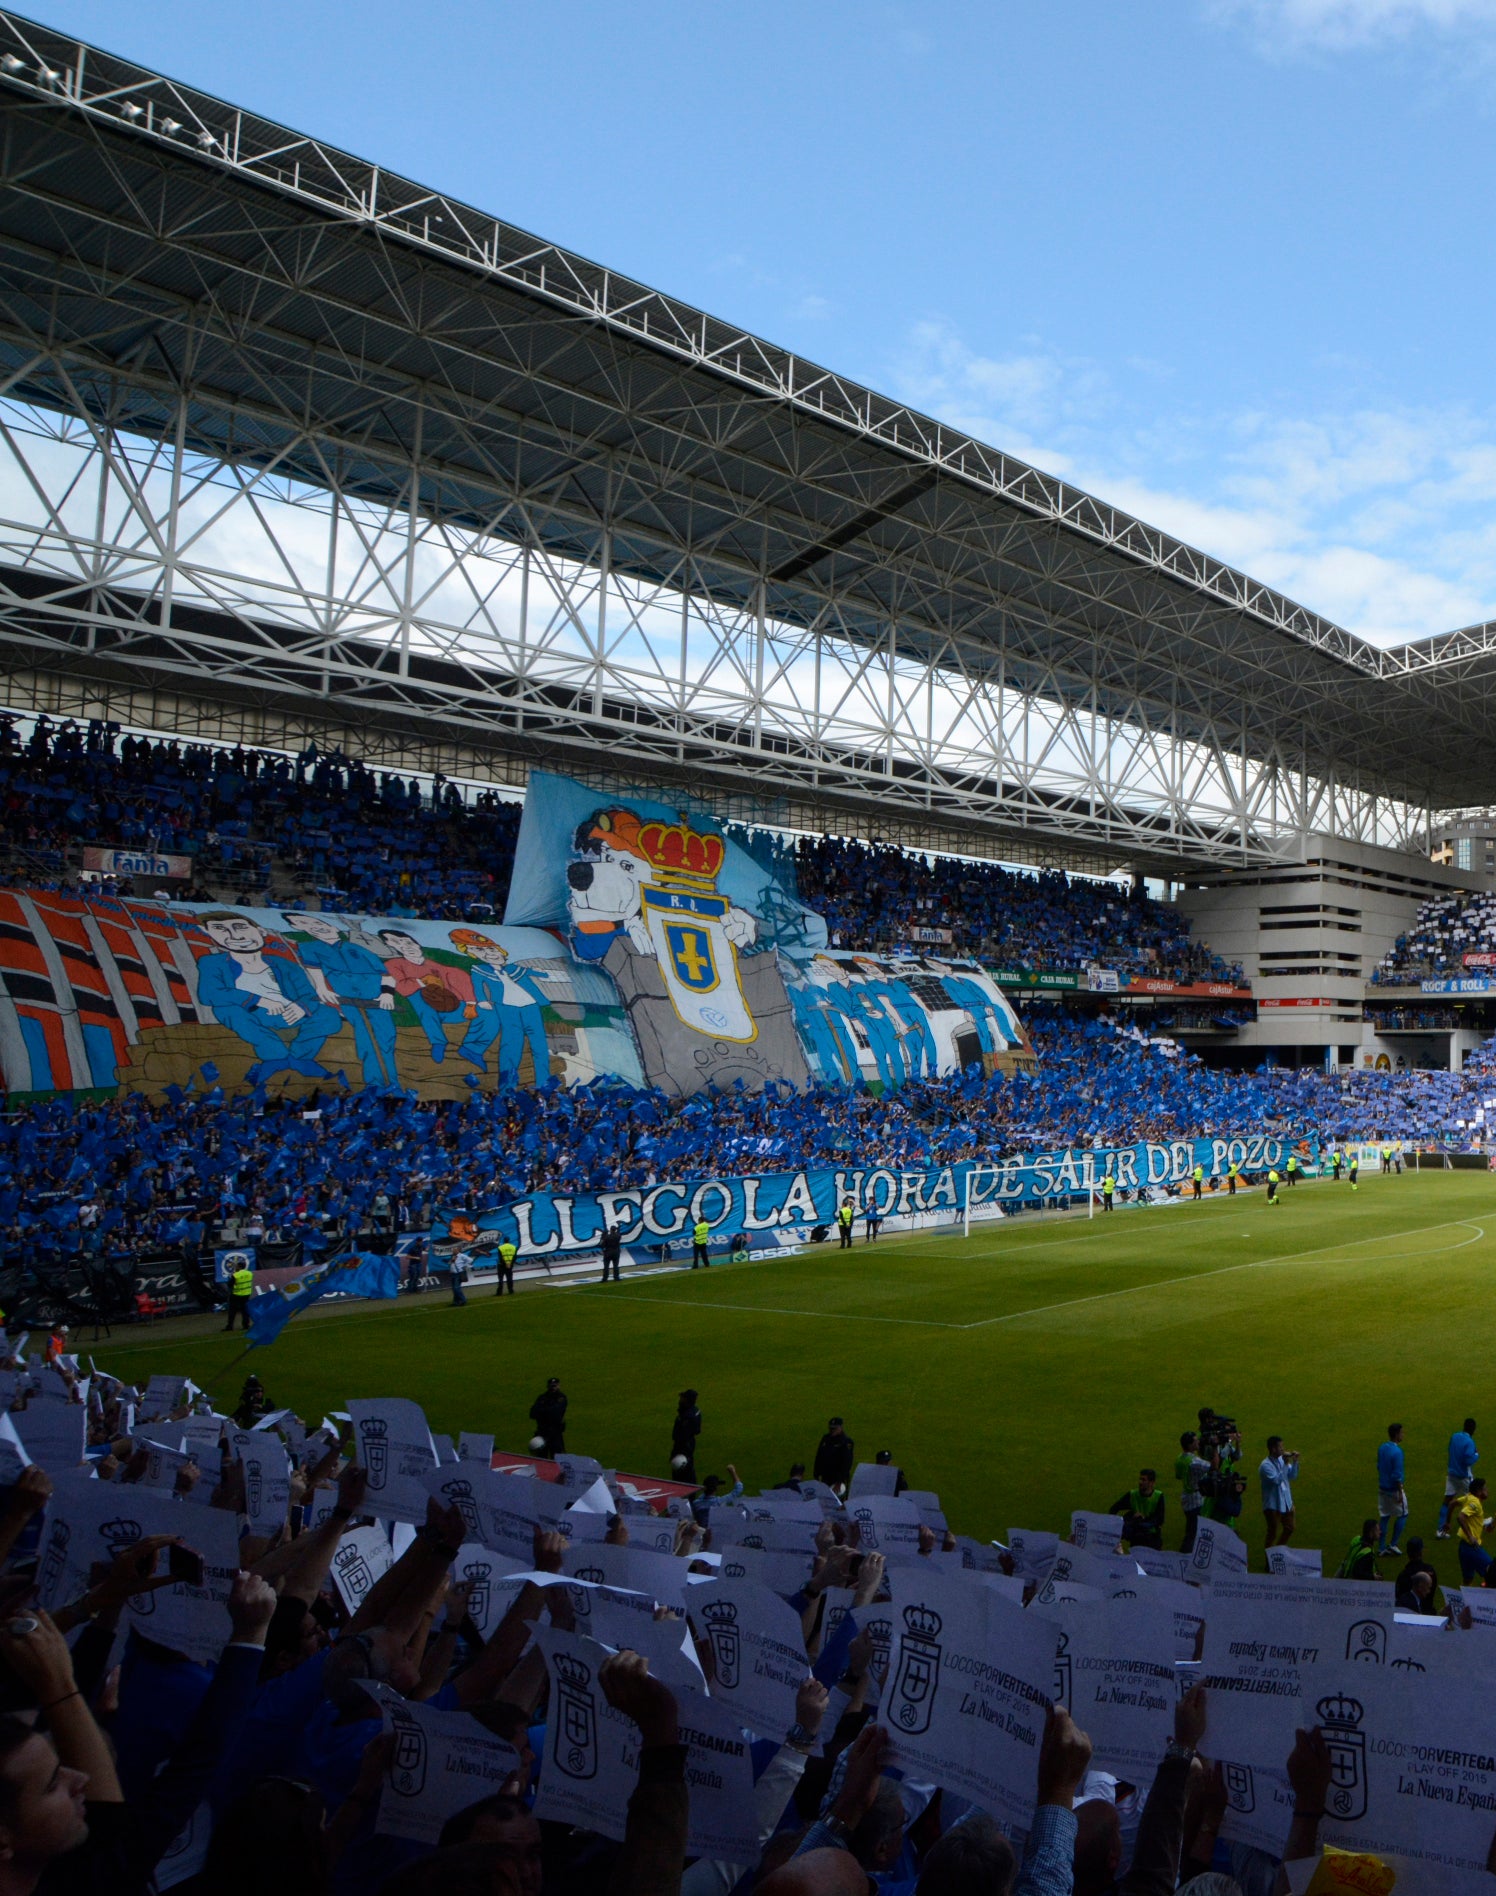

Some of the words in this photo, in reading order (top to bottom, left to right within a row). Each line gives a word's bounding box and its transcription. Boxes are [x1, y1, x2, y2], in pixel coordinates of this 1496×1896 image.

[113, 852, 169, 875] Fanta
[1055, 976, 1075, 985] RURAL
[1147, 981, 1174, 992] cajAstur
[1209, 985, 1233, 995] cajAstur
[1450, 980, 1458, 992] &
[1460, 979, 1486, 991] ROLL
[511, 1181, 735, 1257] LLEGO
[741, 1172, 820, 1231] LA
[833, 1165, 958, 1218] HORA
[969, 1153, 1025, 1201] DE
[1030, 1146, 1140, 1198] SALIR
[1144, 1140, 1196, 1184] DEL
[1210, 1136, 1283, 1176] POZO
[750, 1245, 803, 1261] asac
[1229, 1640, 1265, 1664] España
[1270, 1645, 1297, 1665] Nueva
[1301, 1647, 1320, 1664] La
[753, 1659, 762, 1674] La
[763, 1661, 785, 1683] Nueva
[1238, 1664, 1258, 1676] 2015
[1260, 1667, 1277, 1677] OFF
[1103, 1673, 1124, 1684] PLAY
[1125, 1674, 1142, 1686] OFF
[1143, 1677, 1160, 1689] 2015
[973, 1679, 995, 1697] PLAY
[995, 1687, 1011, 1703] OFF
[1011, 1696, 1031, 1716] 2015
[1094, 1685, 1109, 1703] La
[1109, 1687, 1137, 1705] Nueva
[1137, 1690, 1168, 1711] España
[959, 1692, 976, 1715] La
[977, 1700, 1006, 1730] Nueva
[1005, 1712, 1037, 1748] España
[458, 1756, 482, 1777] Nueva
[1407, 1763, 1435, 1776] PLAY
[1437, 1765, 1457, 1778] OFF
[1462, 1770, 1487, 1785] 2015
[1397, 1775, 1415, 1795] La
[1417, 1778, 1454, 1802] Nueva
[1359, 1838, 1379, 1850] ESTA
[1379, 1842, 1424, 1860] CARTULINA
[1425, 1850, 1442, 1864] POR
[1443, 1854, 1454, 1866] LA
[1455, 1856, 1467, 1869] DE
